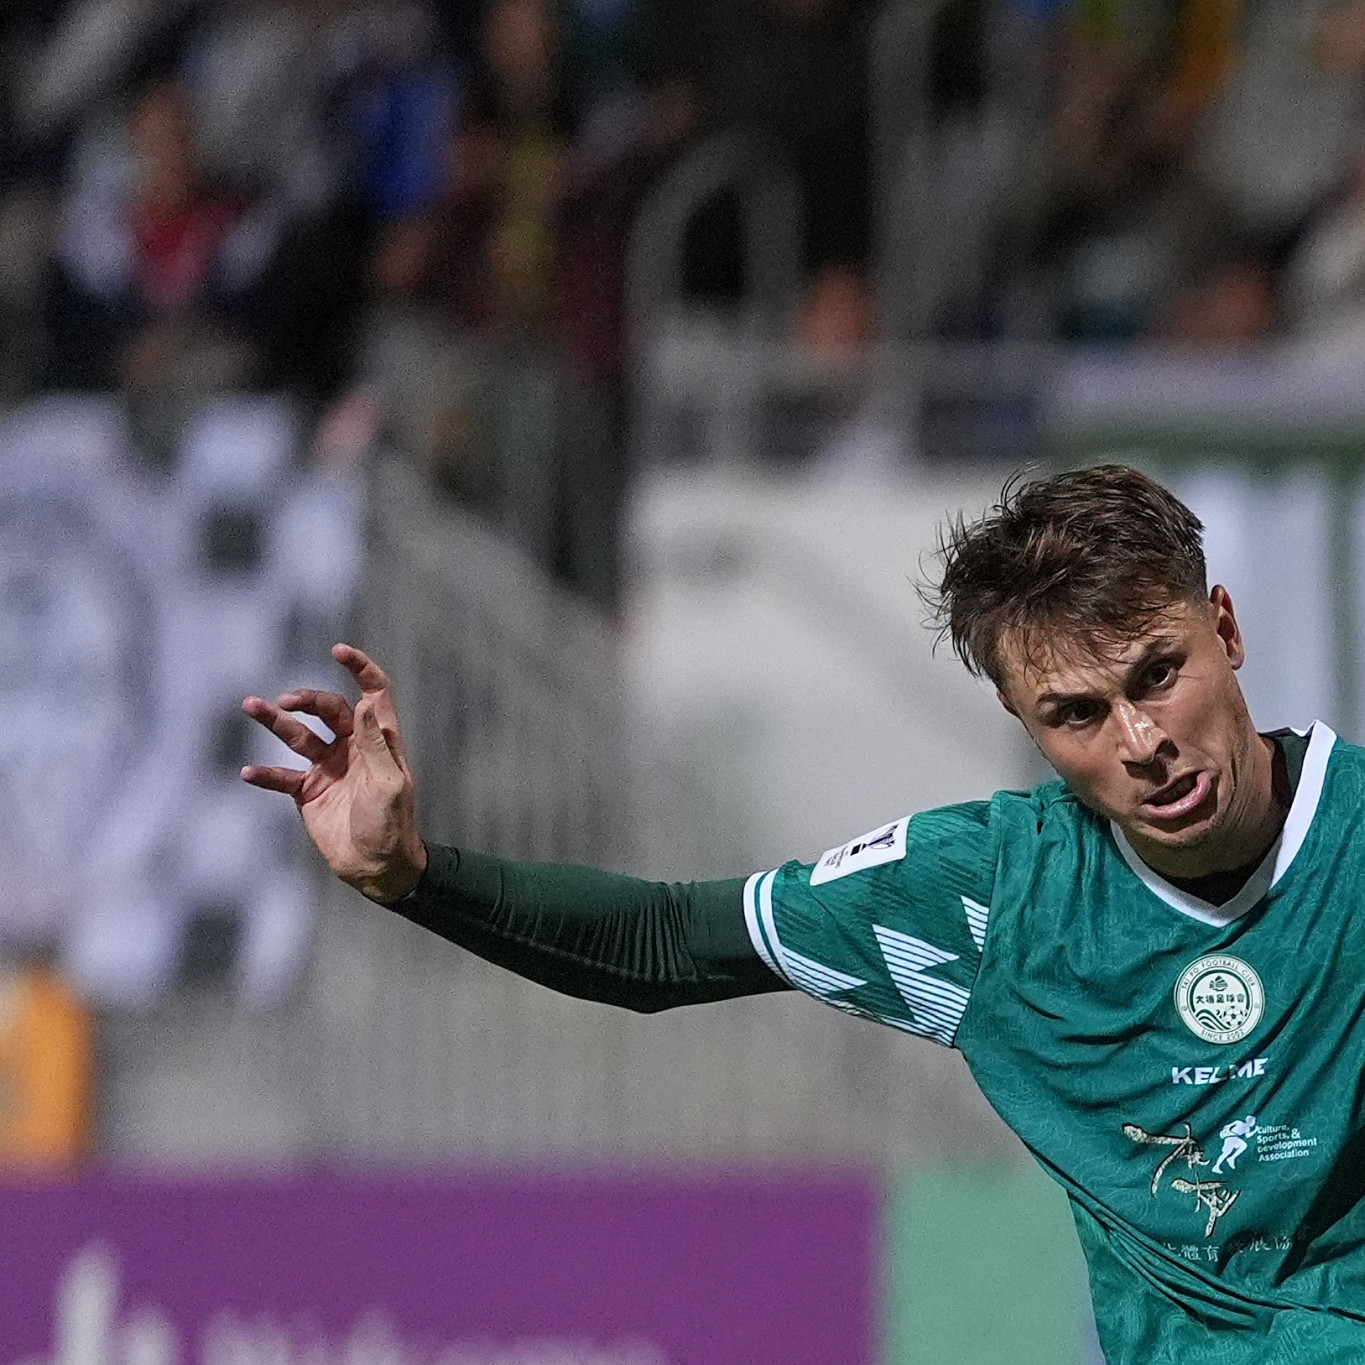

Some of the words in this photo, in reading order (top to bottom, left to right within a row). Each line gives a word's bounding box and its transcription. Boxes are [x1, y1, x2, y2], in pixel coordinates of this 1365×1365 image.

[1190, 967, 1199, 976] PO
[1201, 959, 1239, 970] FOOTBALL
[1241, 969, 1256, 987] CLUB
[1201, 1029, 1223, 1041] SINCE
[1171, 1057, 1268, 1085] KELME
[1256, 1132, 1290, 1144] Sports,
[1291, 1128, 1301, 1139] &
[1259, 1149, 1309, 1162] Association
